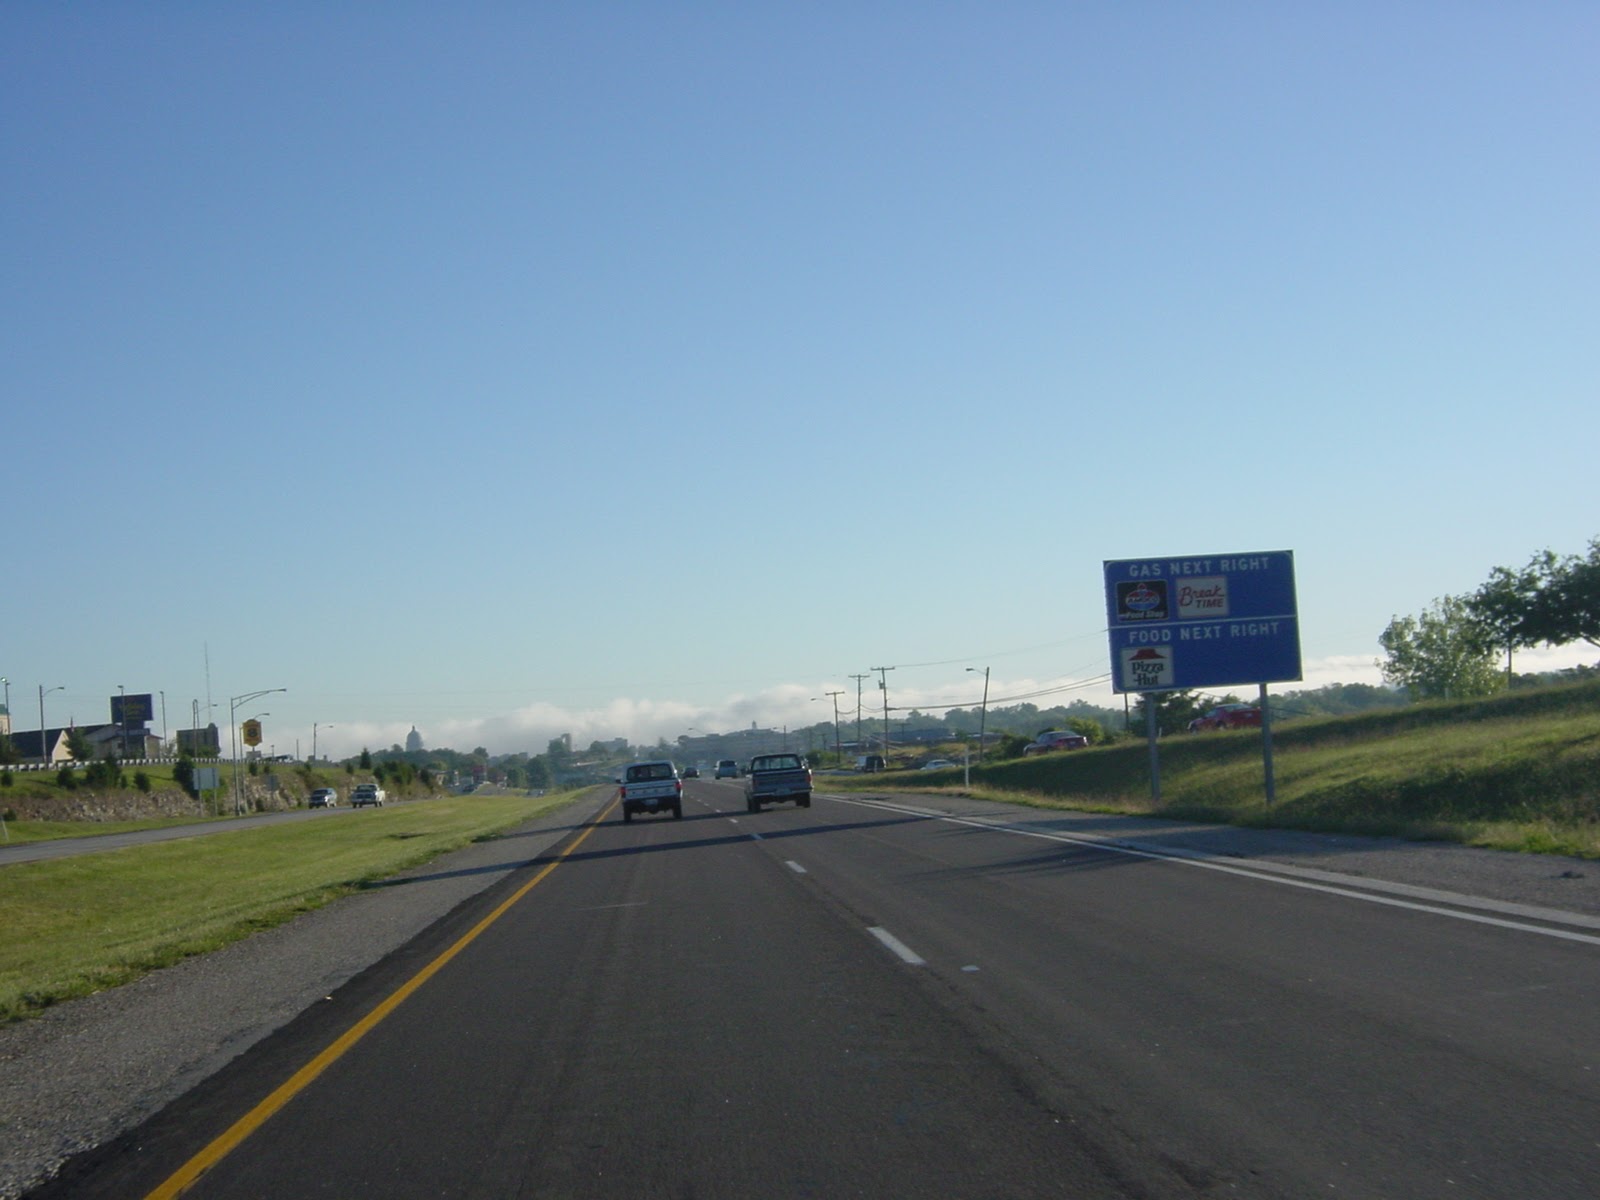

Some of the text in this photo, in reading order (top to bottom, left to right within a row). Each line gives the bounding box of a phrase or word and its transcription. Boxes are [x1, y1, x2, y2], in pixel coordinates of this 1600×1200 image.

[1129, 557, 1270, 577] GAS NEXT RIGHT
[1179, 585, 1225, 607] Break
[1196, 598, 1224, 609] TIME
[1129, 622, 1280, 643] FOOD NEXT RIGHT
[1131, 661, 1164, 674] Pizza
[1134, 672, 1159, 686] Hut
